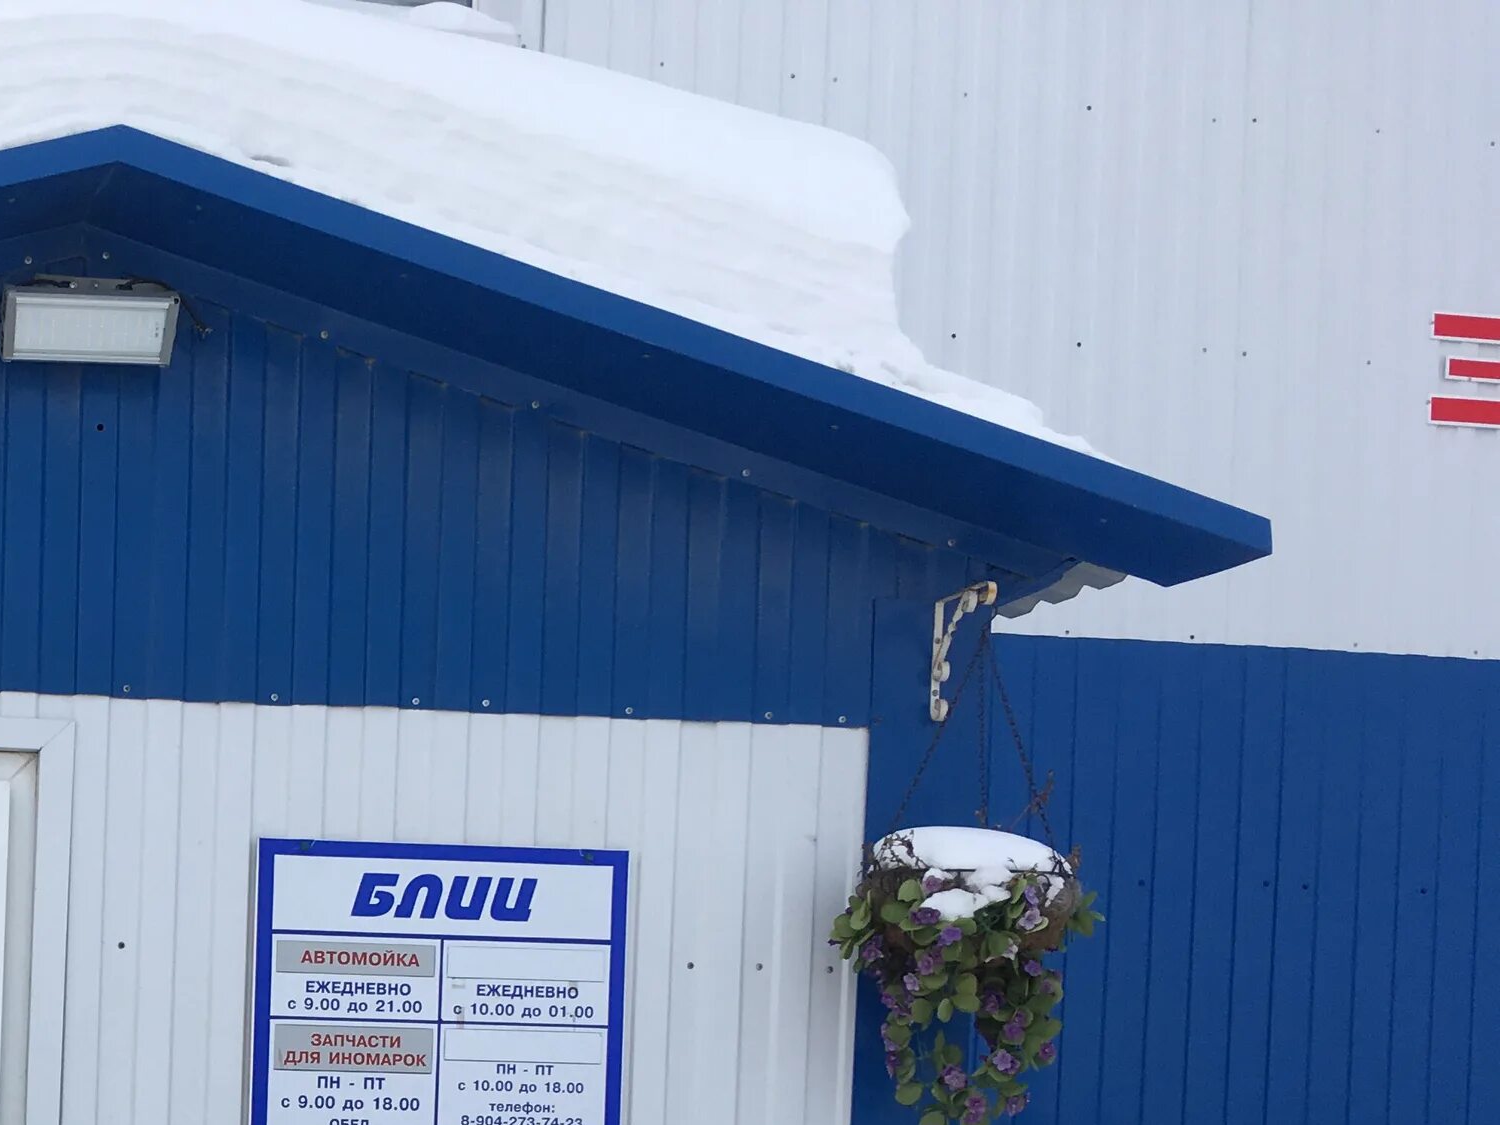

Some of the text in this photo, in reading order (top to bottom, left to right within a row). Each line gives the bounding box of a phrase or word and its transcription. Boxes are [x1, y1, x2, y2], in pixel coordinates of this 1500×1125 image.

[351, 872, 538, 922] БЛИЦ
[301, 949, 420, 967] АВТОМОЙКА
[305, 980, 411, 996] ЕЖЕДНЕВНО
[476, 983, 579, 1000] ЕЖЕДНЕВНО
[288, 998, 422, 1014] с 9.00 до 21.00
[453, 1002, 594, 1019] с 10.00 до 01.00
[311, 1033, 401, 1049] ЗАПЧАСТИ
[284, 1051, 427, 1067] ДЛЯ ИНОМАРОК
[496, 1064, 517, 1076] ПН
[535, 1065, 553, 1076] ПТ
[317, 1076, 340, 1089] ПН
[363, 1077, 385, 1090] ПТ
[458, 1080, 584, 1094] с 10.00 до 18.00
[281, 1095, 420, 1112] с 9.00 до 18.00
[489, 1101, 555, 1116] телефон:
